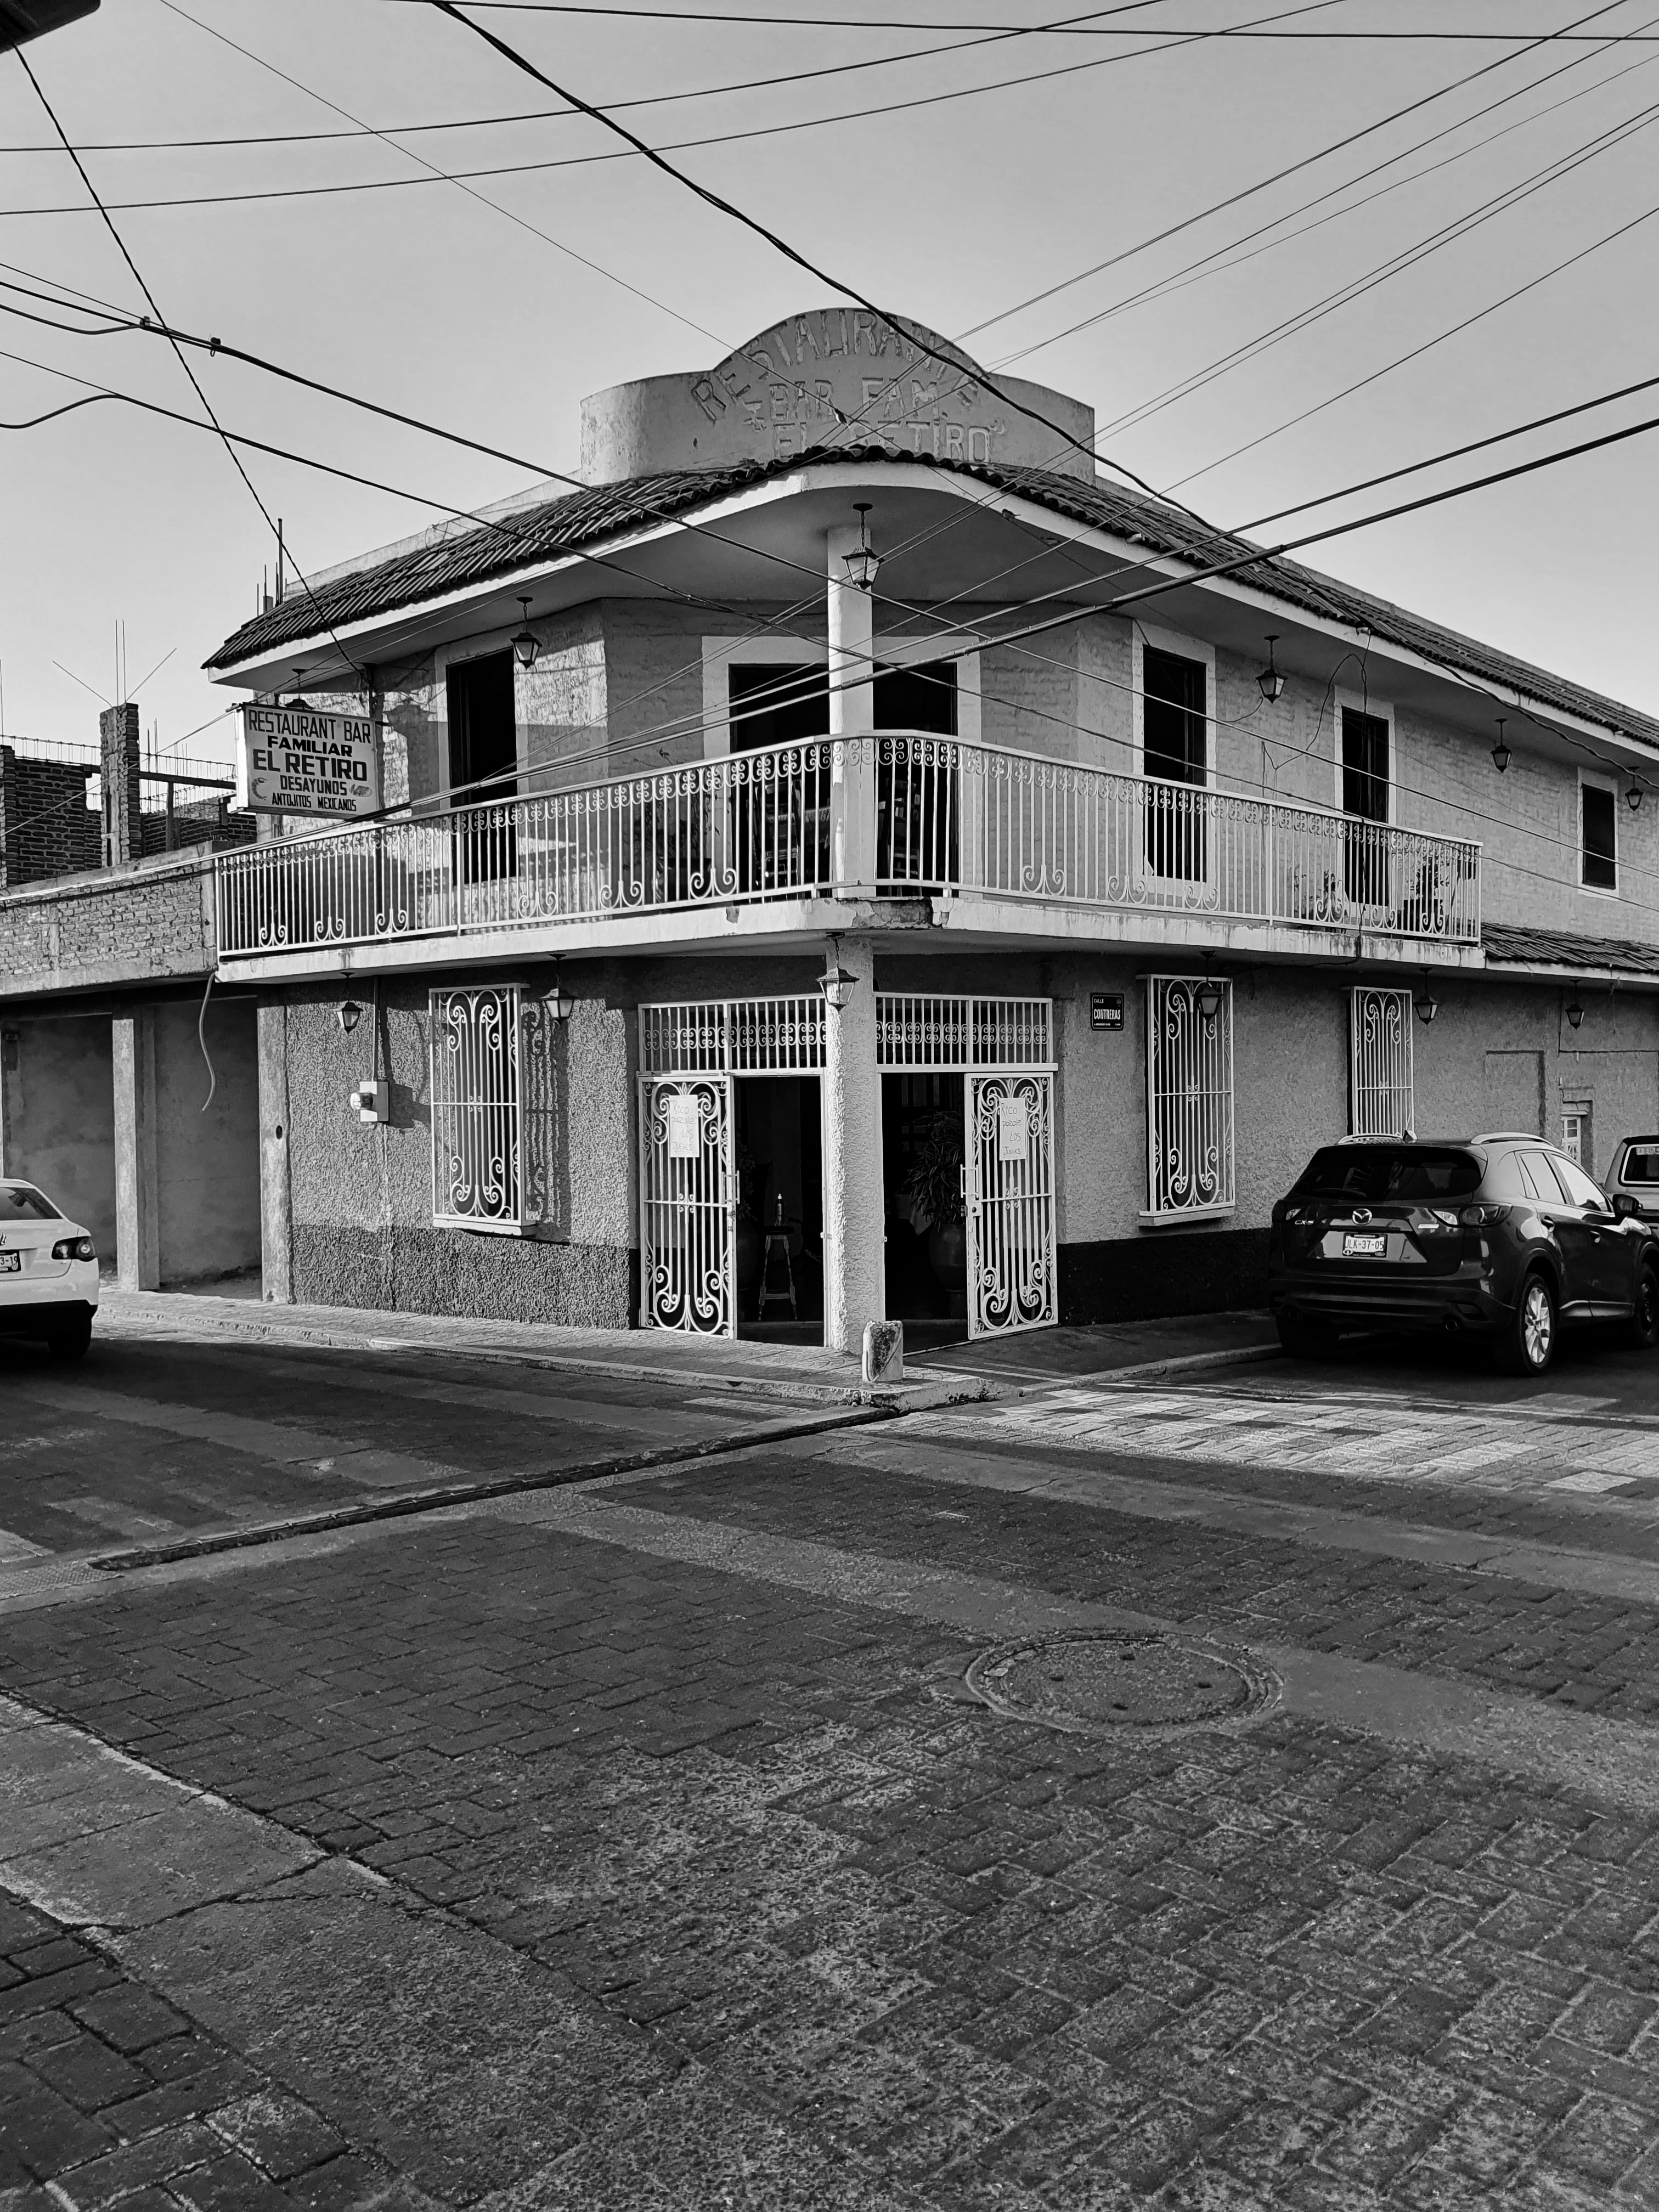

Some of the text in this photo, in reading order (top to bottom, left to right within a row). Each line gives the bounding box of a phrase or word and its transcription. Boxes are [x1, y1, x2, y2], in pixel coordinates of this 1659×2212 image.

[769, 379, 835, 420] BAR
[249, 709, 371, 744] RESTAURANT BAR
[267, 735, 352, 757] FAMILIAR
[253, 748, 367, 781] EL RETIRO
[280, 775, 347, 796] DESAYUNOS
[272, 792, 357, 812] ANTOJITOS MEXICANOS
[1093, 1008, 1121, 1020] CONTRERAS
[682, 1128, 694, 1139] LOS
[1009, 1132, 1022, 1142] LOS
[1345, 1239, 1384, 1250] JLK-37-05
